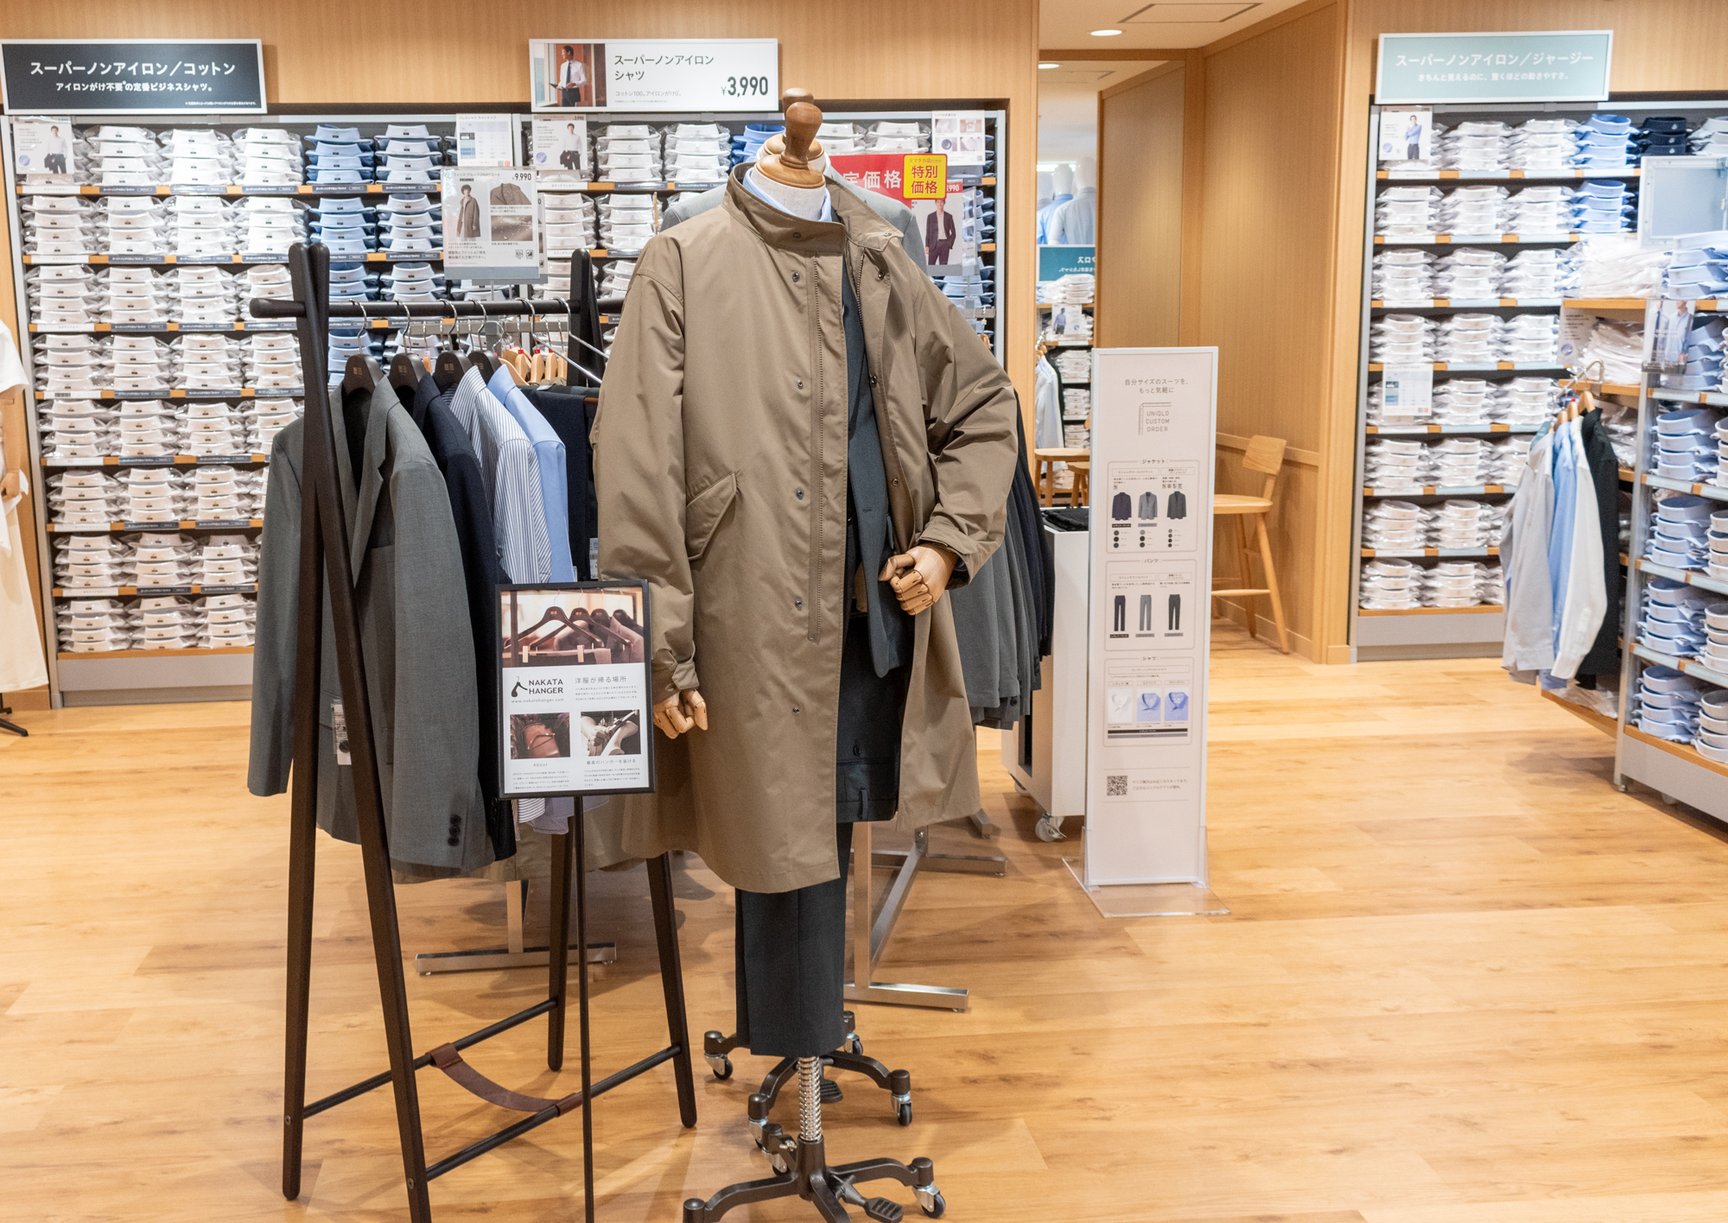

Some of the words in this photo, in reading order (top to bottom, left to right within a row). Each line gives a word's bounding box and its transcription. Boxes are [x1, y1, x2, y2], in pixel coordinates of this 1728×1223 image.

[614, 54, 715, 66] スーパーノンアイロン
[614, 70, 645, 81] シャツ
[911, 165, 938, 179] 特別
[911, 181, 938, 195] 価格
[528, 678, 564, 687] NAKATA
[528, 687, 564, 695] HANGER
